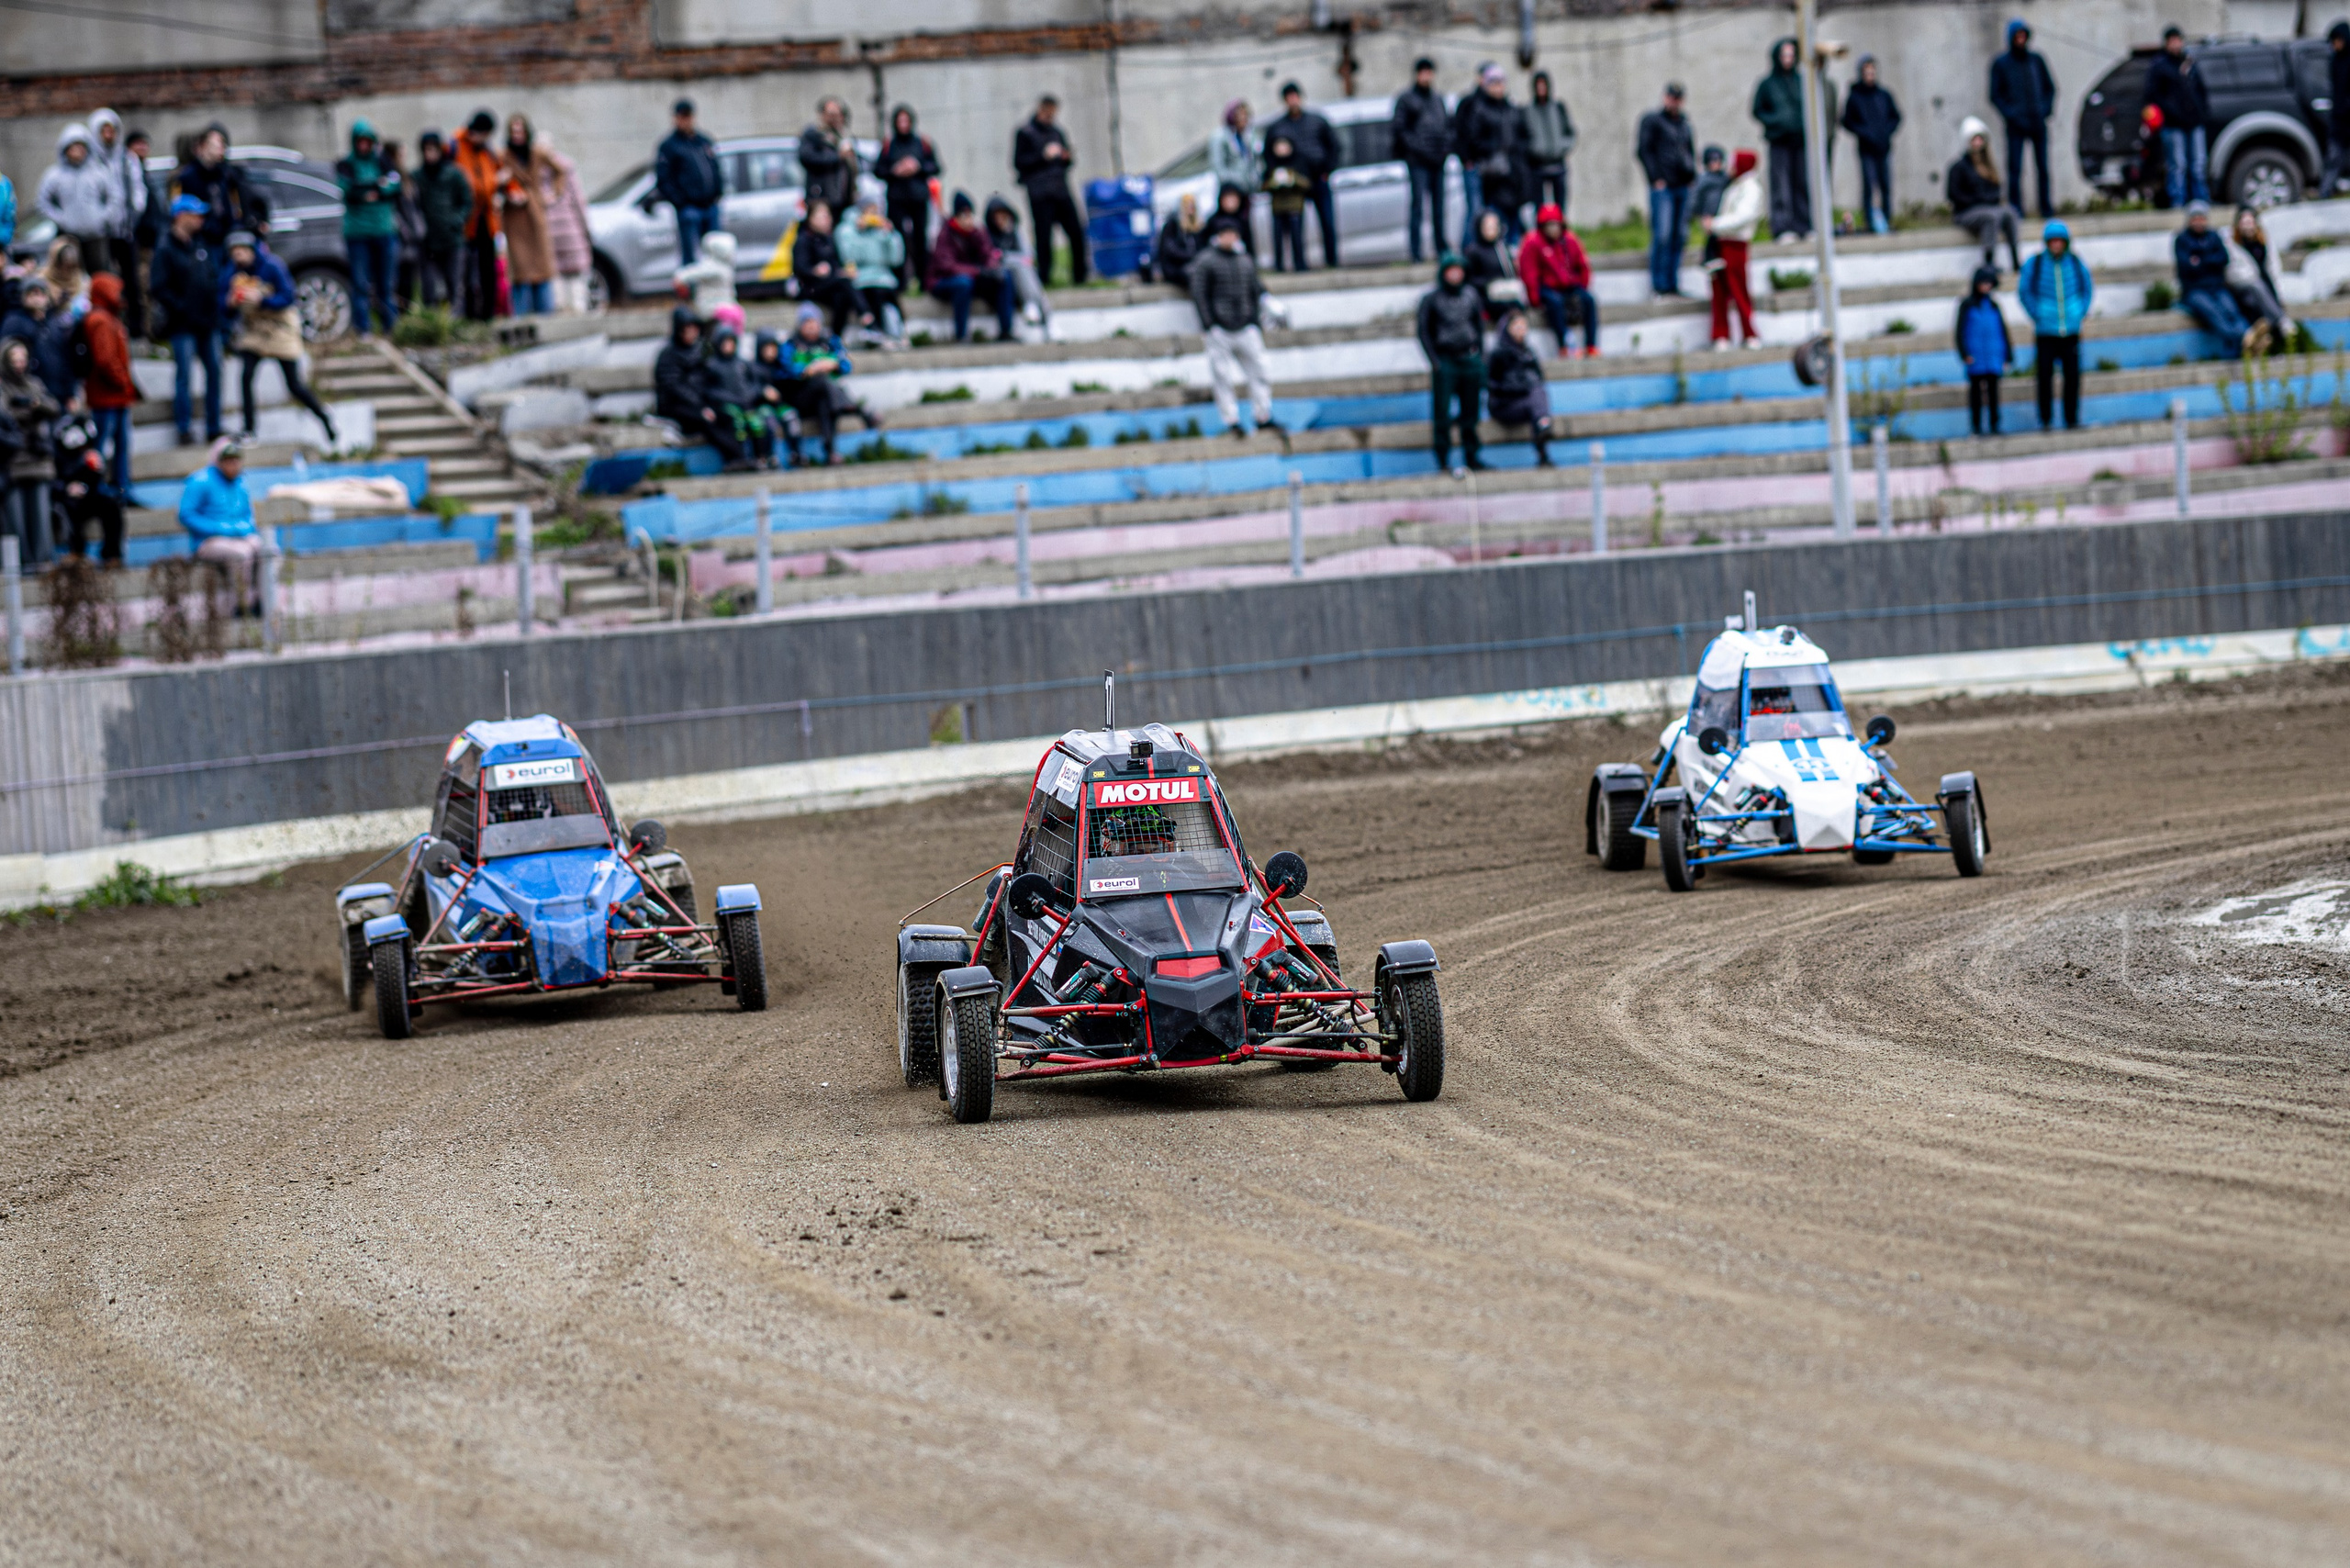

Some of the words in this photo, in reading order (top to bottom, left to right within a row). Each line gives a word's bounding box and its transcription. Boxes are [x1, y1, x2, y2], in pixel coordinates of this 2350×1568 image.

[517, 762, 570, 777] eurol
[1101, 780, 1194, 804] MOTUL
[1104, 879, 1136, 887] eurol
